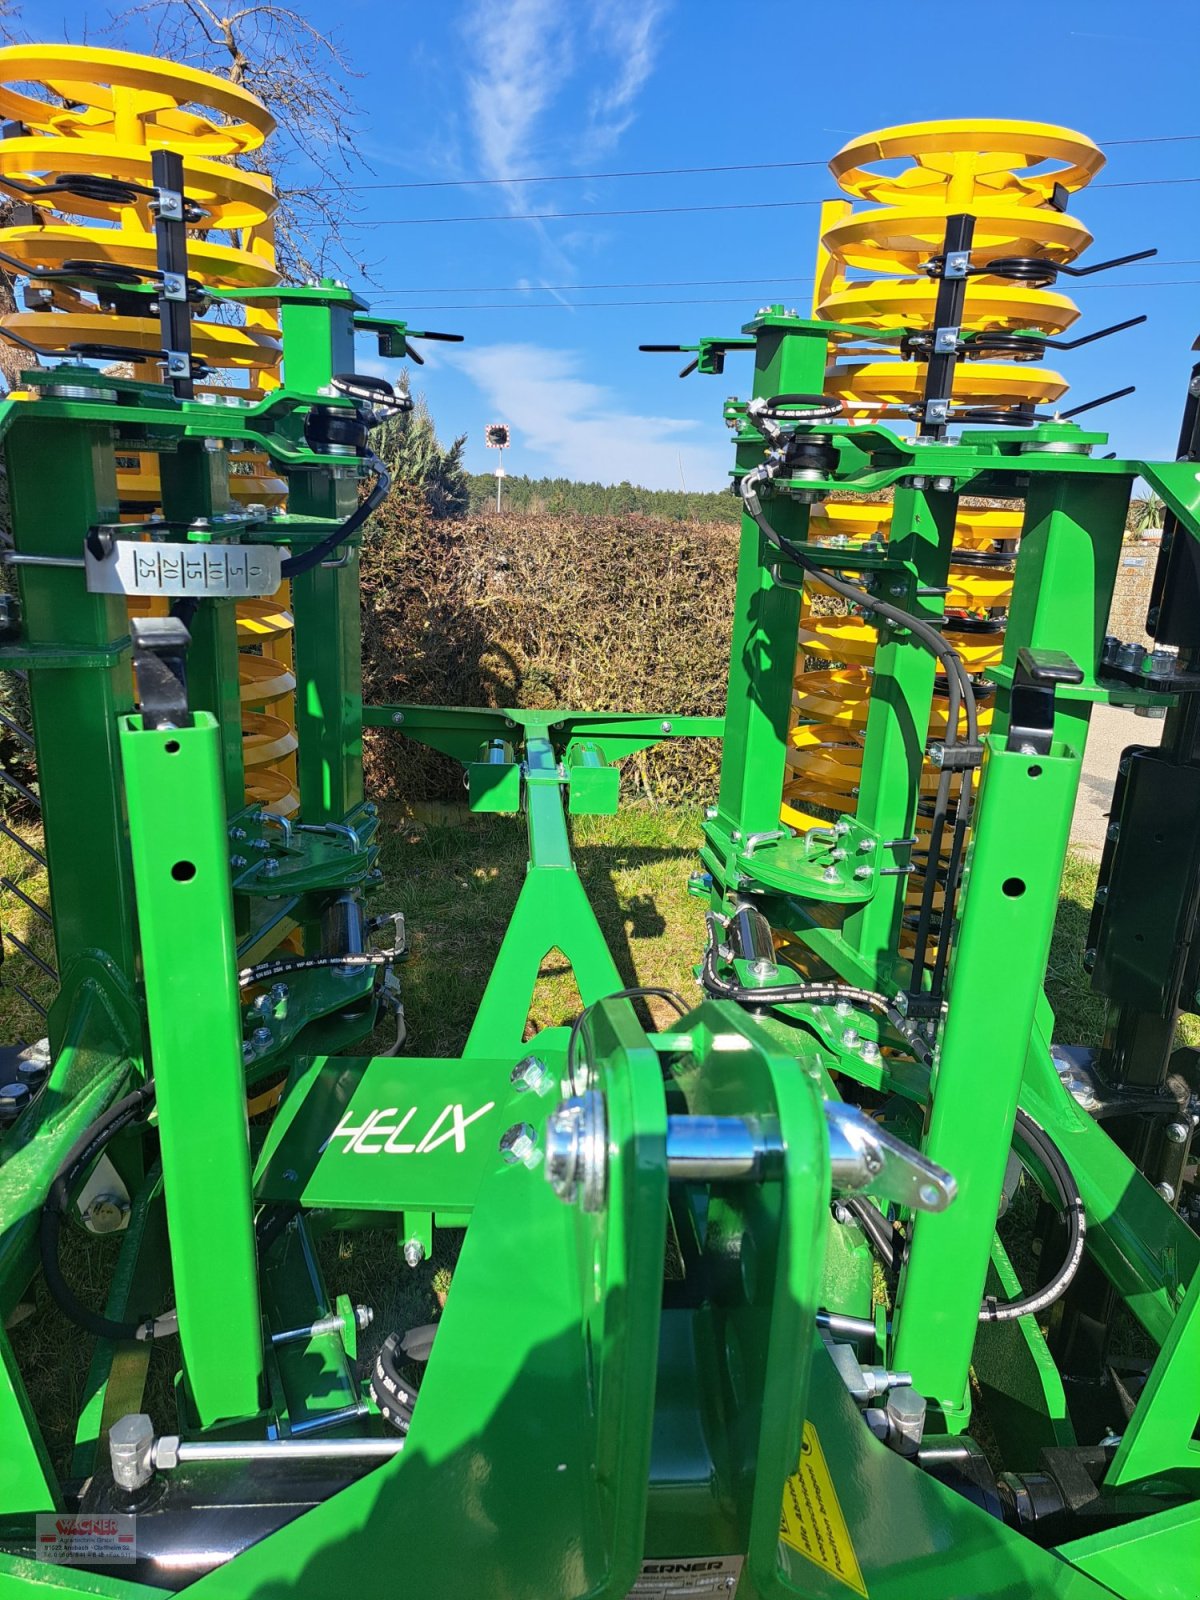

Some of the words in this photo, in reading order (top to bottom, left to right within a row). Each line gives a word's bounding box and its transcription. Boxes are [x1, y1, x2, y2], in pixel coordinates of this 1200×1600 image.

[138, 558, 156, 578] 25
[162, 558, 179, 579] 20
[186, 560, 202, 579] 15
[208, 560, 223, 580] 10
[230, 567, 244, 576] 5
[249, 566, 262, 576] 0
[318, 1101, 495, 1154] HELIX
[643, 1561, 724, 1574] ERNER
